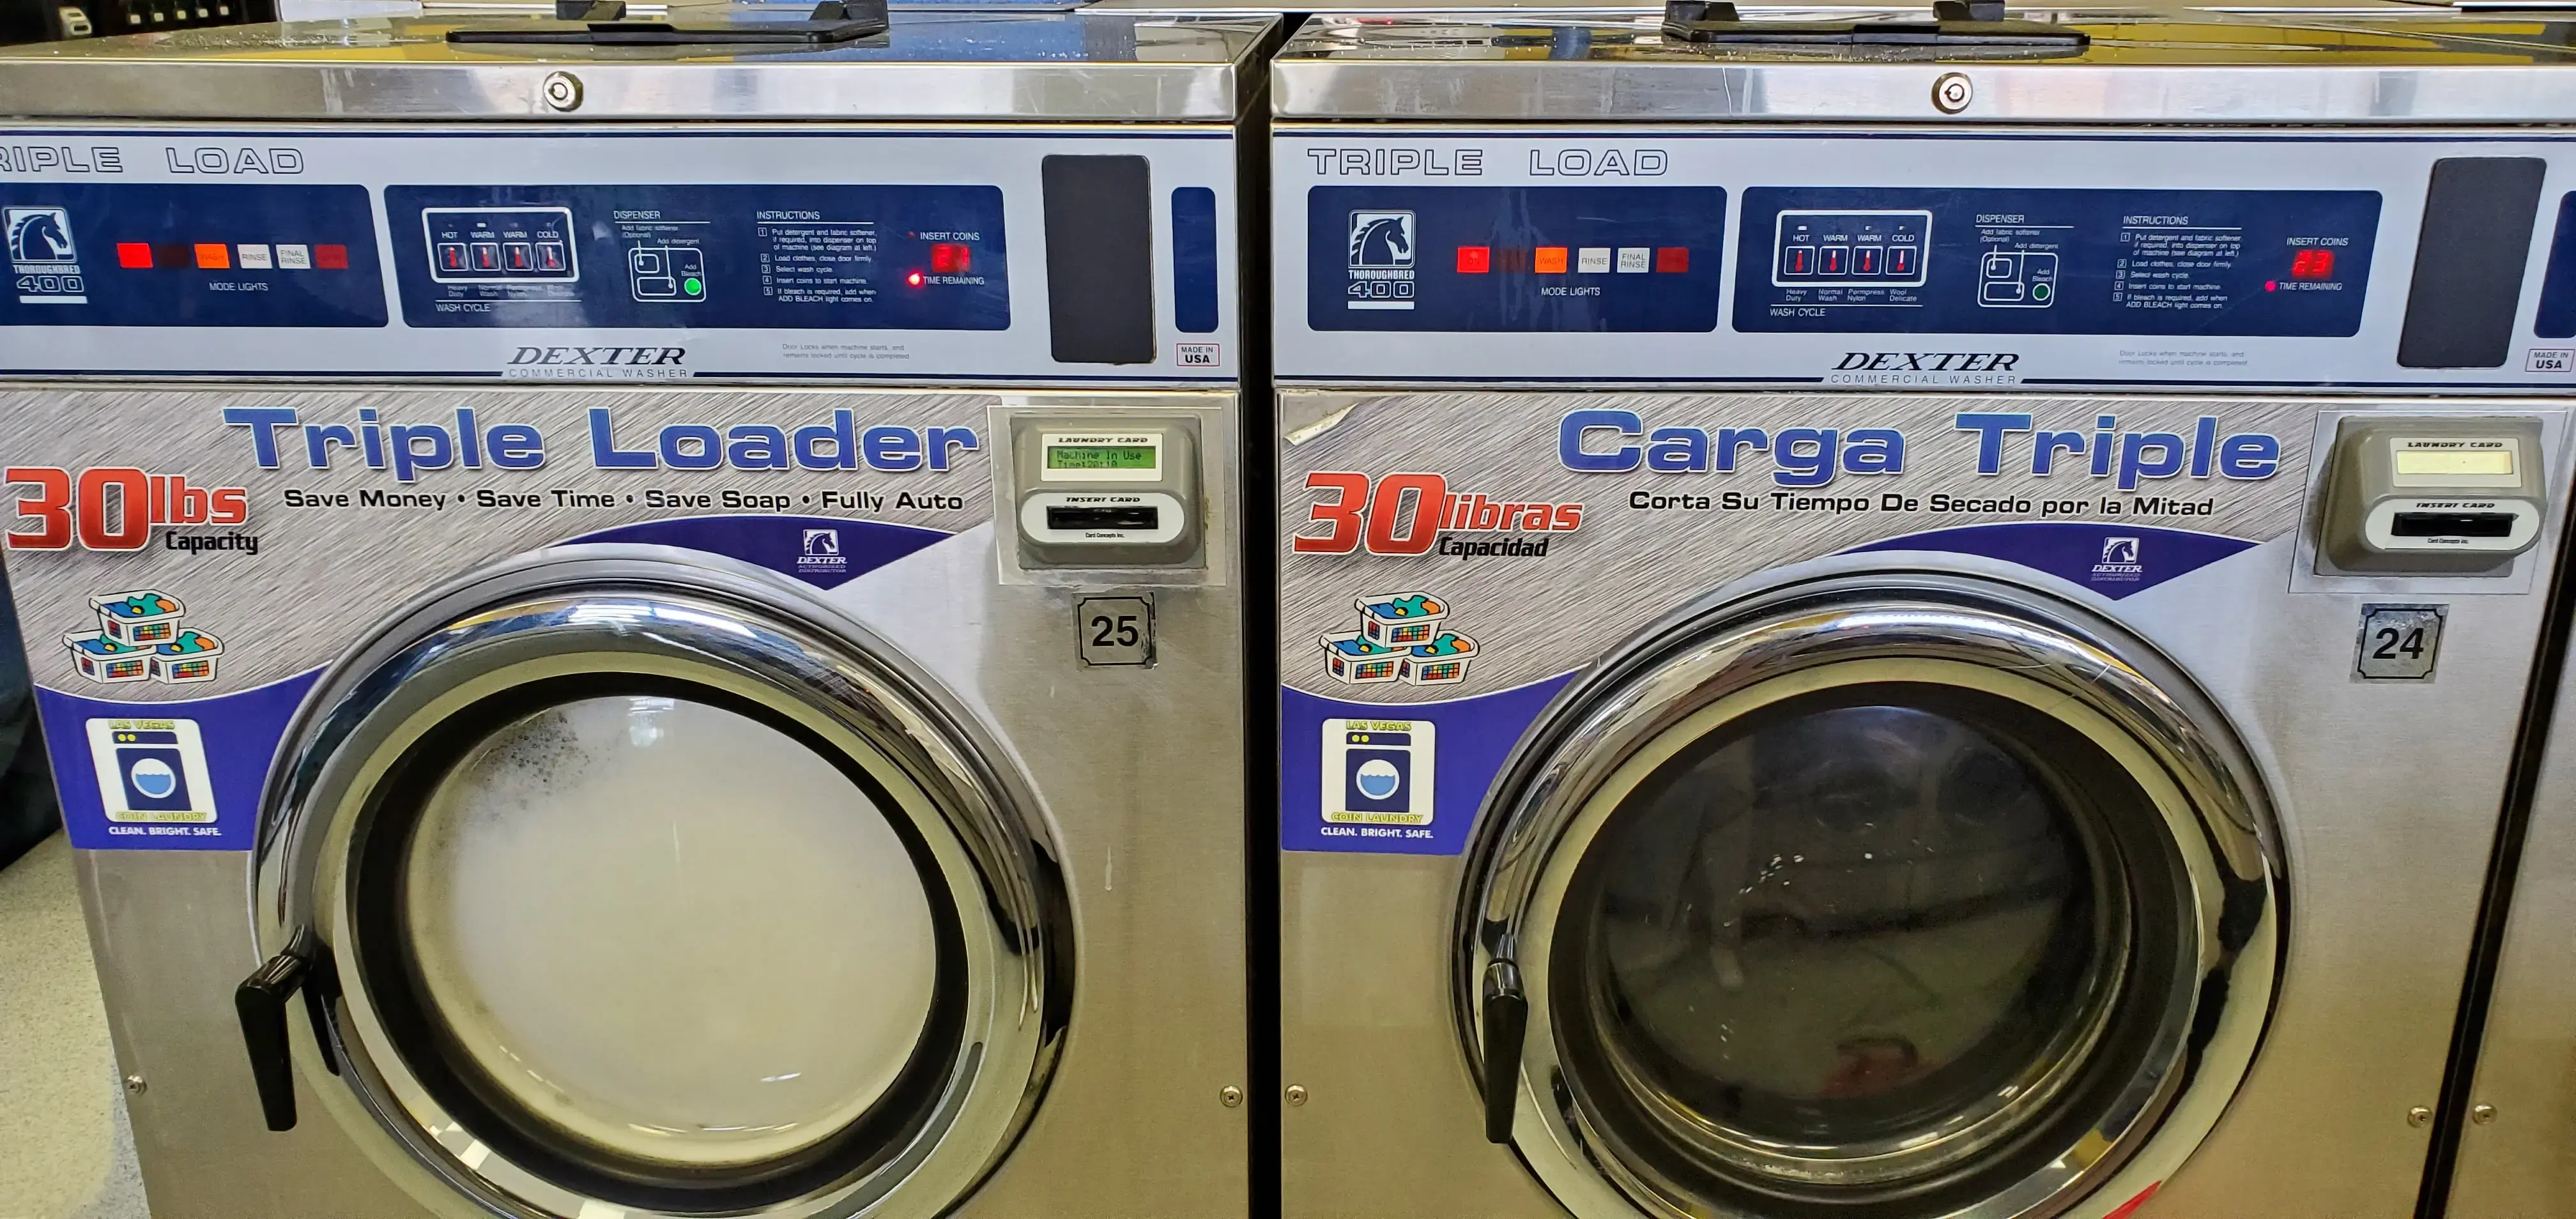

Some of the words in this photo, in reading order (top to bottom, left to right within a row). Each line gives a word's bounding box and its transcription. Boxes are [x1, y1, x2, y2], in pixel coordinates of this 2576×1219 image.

[166, 148, 303, 174] LOAD
[1307, 148, 1483, 176] TRIPLE
[1529, 149, 1669, 176] LOAD
[1976, 215, 2024, 223] DISPENSER
[2123, 216, 2188, 224] INSTRUCTIONS
[2294, 252, 2328, 273] 23
[13, 264, 80, 273] THOROUGHBRED
[1348, 270, 1414, 279] THOROUGHBRED
[16, 275, 84, 292] 400
[210, 282, 236, 291] MODE
[238, 282, 268, 291] LIGHTS
[1348, 281, 1414, 298] 400
[1542, 287, 1567, 296] MODE
[1570, 288, 1600, 296] LIGHTS
[507, 347, 686, 365] DEXTER
[1185, 355, 1209, 364] USA
[1832, 353, 2020, 371] DEXTER
[2536, 360, 2562, 369] USA
[509, 369, 613, 377] COMMERCIAL
[622, 369, 687, 377] WASHER
[1831, 374, 1938, 383] COMMERCIAL
[1950, 375, 2015, 384] WASHER
[223, 407, 546, 483] Triple
[588, 407, 979, 471] Loader
[1558, 408, 1906, 487] Carga
[1954, 412, 2281, 491] Triple
[1057, 450, 1100, 459] Machine
[1107, 450, 1117, 459] In
[1123, 450, 1141, 459] Use
[284, 489, 349, 507] Save
[360, 490, 446, 510] Money
[477, 490, 541, 507] Save
[551, 490, 615, 507] Time
[646, 490, 712, 508] Save
[723, 491, 791, 512] Soap
[822, 491, 884, 512] Fully
[896, 492, 963, 509] Auto
[1630, 491, 1710, 509] Corta
[1722, 492, 1759, 510] Su
[1770, 493, 1869, 514] Tiempo
[1882, 493, 1918, 512] De
[1929, 494, 2031, 514] Secado
[2041, 498, 2089, 517] por
[2100, 498, 2122, 514] la
[2133, 498, 2214, 516] Mitad
[165, 531, 258, 555] Capacity
[1439, 537, 1549, 560] Capacidad
[1091, 616, 1139, 647] 25
[2373, 627, 2424, 659] 24
[108, 720, 131, 729] LAS
[135, 720, 174, 730] VEGAS
[1346, 721, 1367, 730] LAS
[1371, 721, 1411, 731] VEGAS
[116, 812, 148, 820] COIN
[150, 812, 206, 821] LAUNDRY
[1331, 813, 1362, 822] COIN
[1366, 813, 1423, 823] LAUNDRY
[109, 827, 146, 835] CLEAN.
[1321, 827, 1357, 836] CLEAN.
[1361, 829, 1403, 838] BRIGHT.
[1406, 830, 1433, 838] SAFE.
